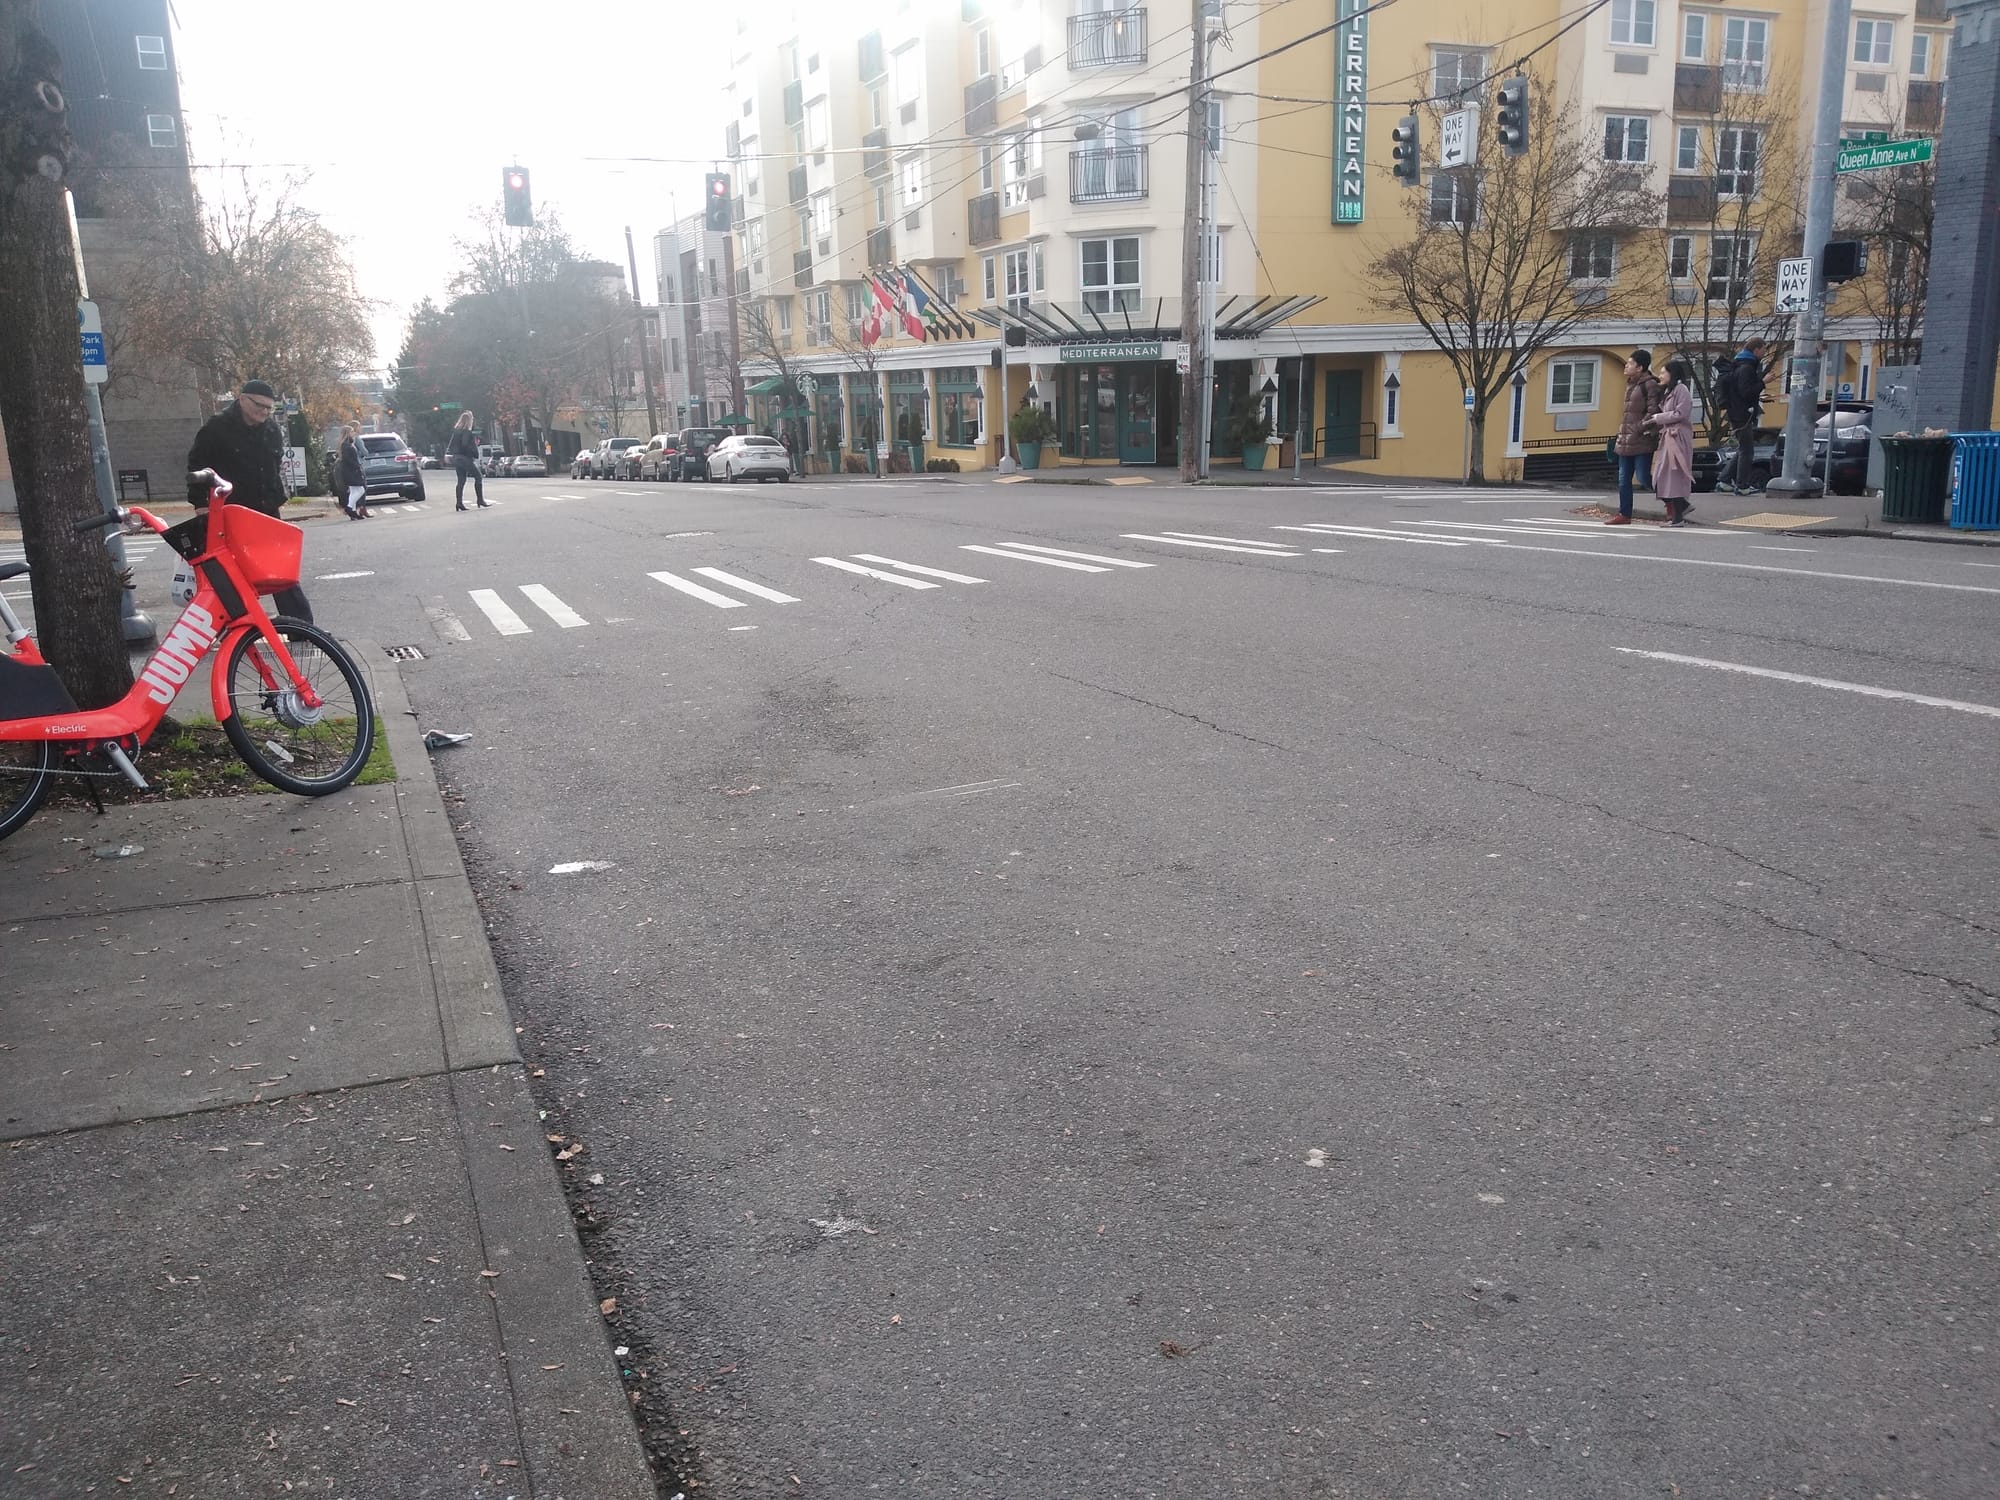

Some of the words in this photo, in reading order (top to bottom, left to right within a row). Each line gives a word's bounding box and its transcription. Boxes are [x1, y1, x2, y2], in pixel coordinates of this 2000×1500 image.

[1445, 117, 1463, 131] ONE
[1445, 130, 1463, 145] WAY
[1840, 152, 1868, 169] Queen
[1870, 149, 1895, 166] Anne
[1895, 150, 1909, 162] Ave
[1910, 147, 1917, 159] N
[1783, 263, 1808, 277] ONE
[1781, 279, 1807, 291] WAY
[81, 336, 101, 344] Park
[1062, 347, 1158, 358] MEDITERRANEAN
[141, 603, 217, 704] JUMP
[52, 725, 87, 734] Electric
